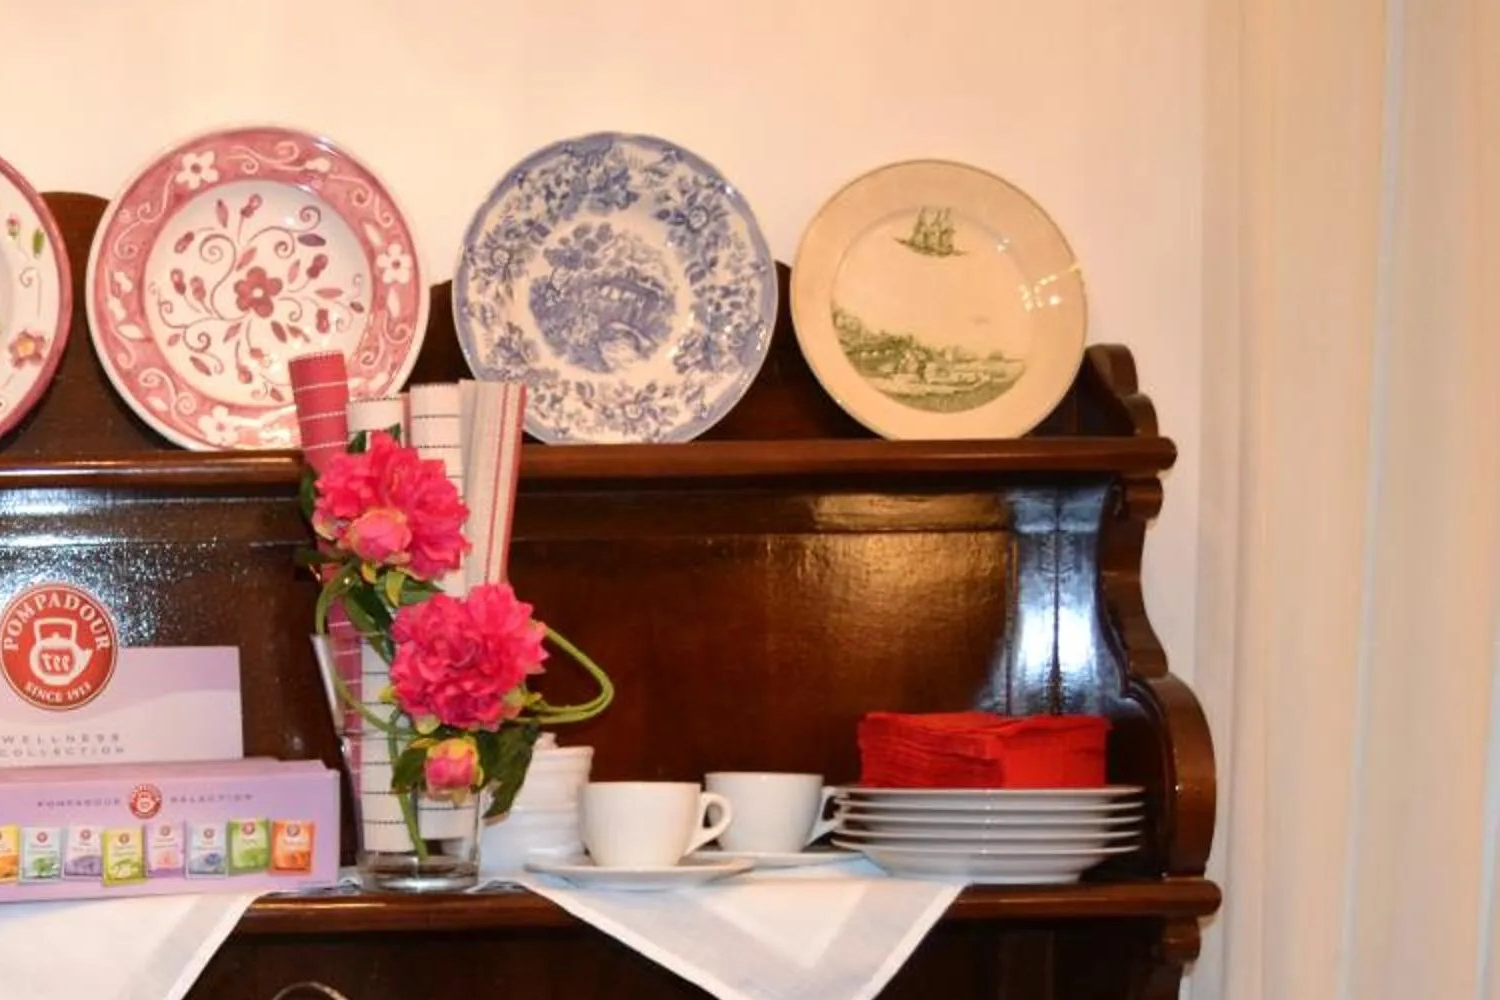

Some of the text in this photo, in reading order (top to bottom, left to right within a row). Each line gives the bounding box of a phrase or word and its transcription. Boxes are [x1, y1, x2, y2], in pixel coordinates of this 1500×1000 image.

[3, 592, 111, 650] POMPADOUR
[24, 681, 63, 702] SINCE
[2, 733, 120, 744] WELLNESS
